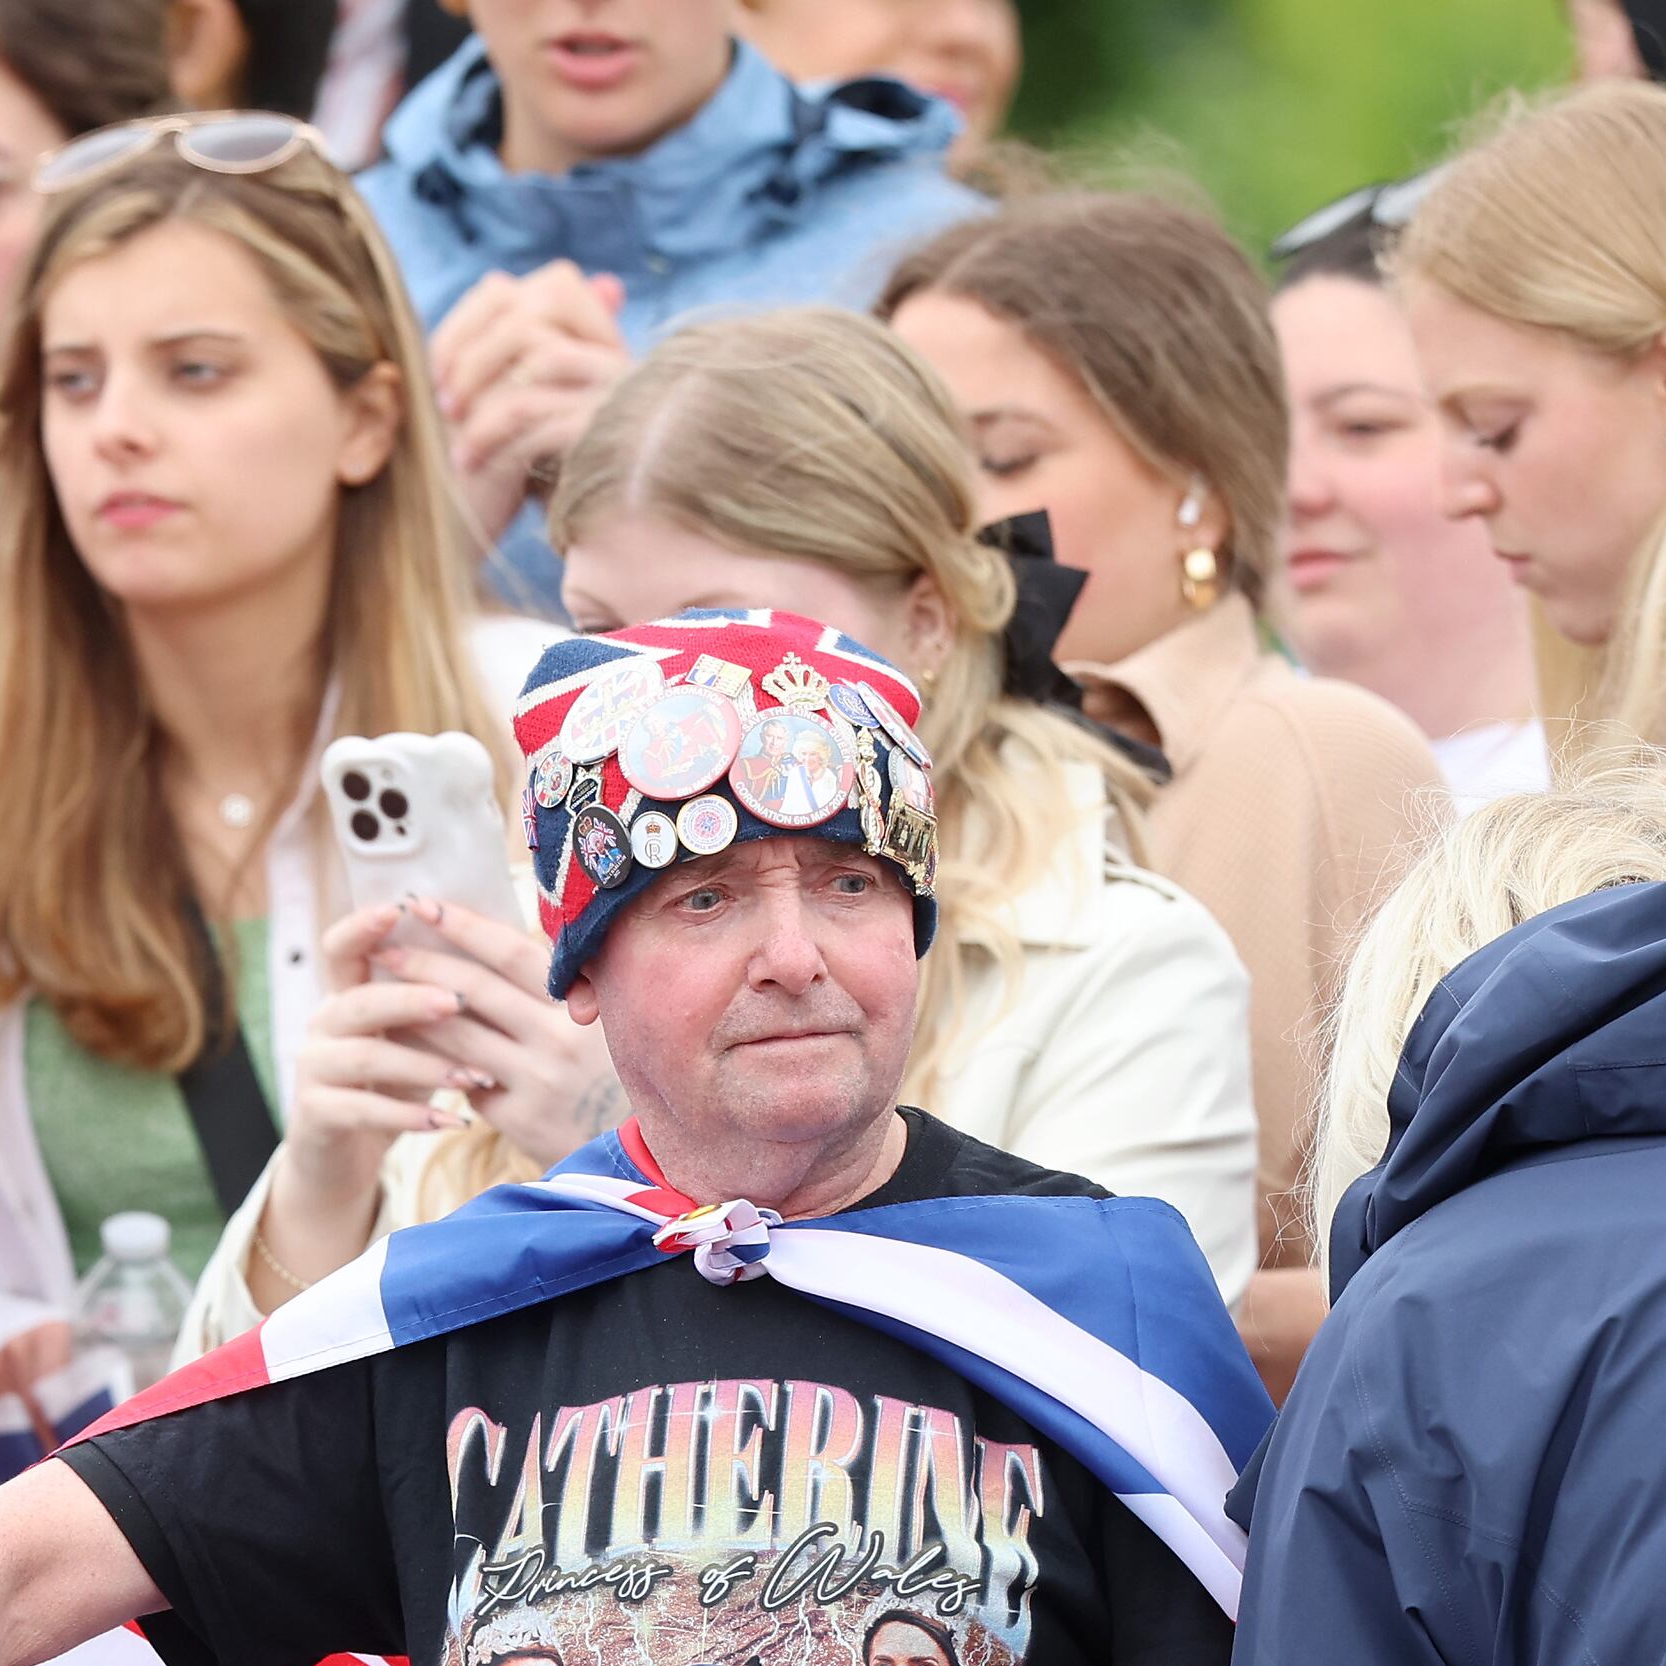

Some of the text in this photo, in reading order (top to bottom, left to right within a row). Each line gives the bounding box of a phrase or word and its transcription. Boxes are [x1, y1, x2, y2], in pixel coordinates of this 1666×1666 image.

[742, 710, 768, 732] SAVE
[770, 707, 790, 716] THE
[793, 707, 820, 723] KING
[828, 727, 852, 763] QUEEN
[735, 781, 847, 825] CORONATION 6th MAY 2023
[447, 1378, 1045, 1655] CATHERINE
[478, 1523, 982, 1616] Princess of Wales
